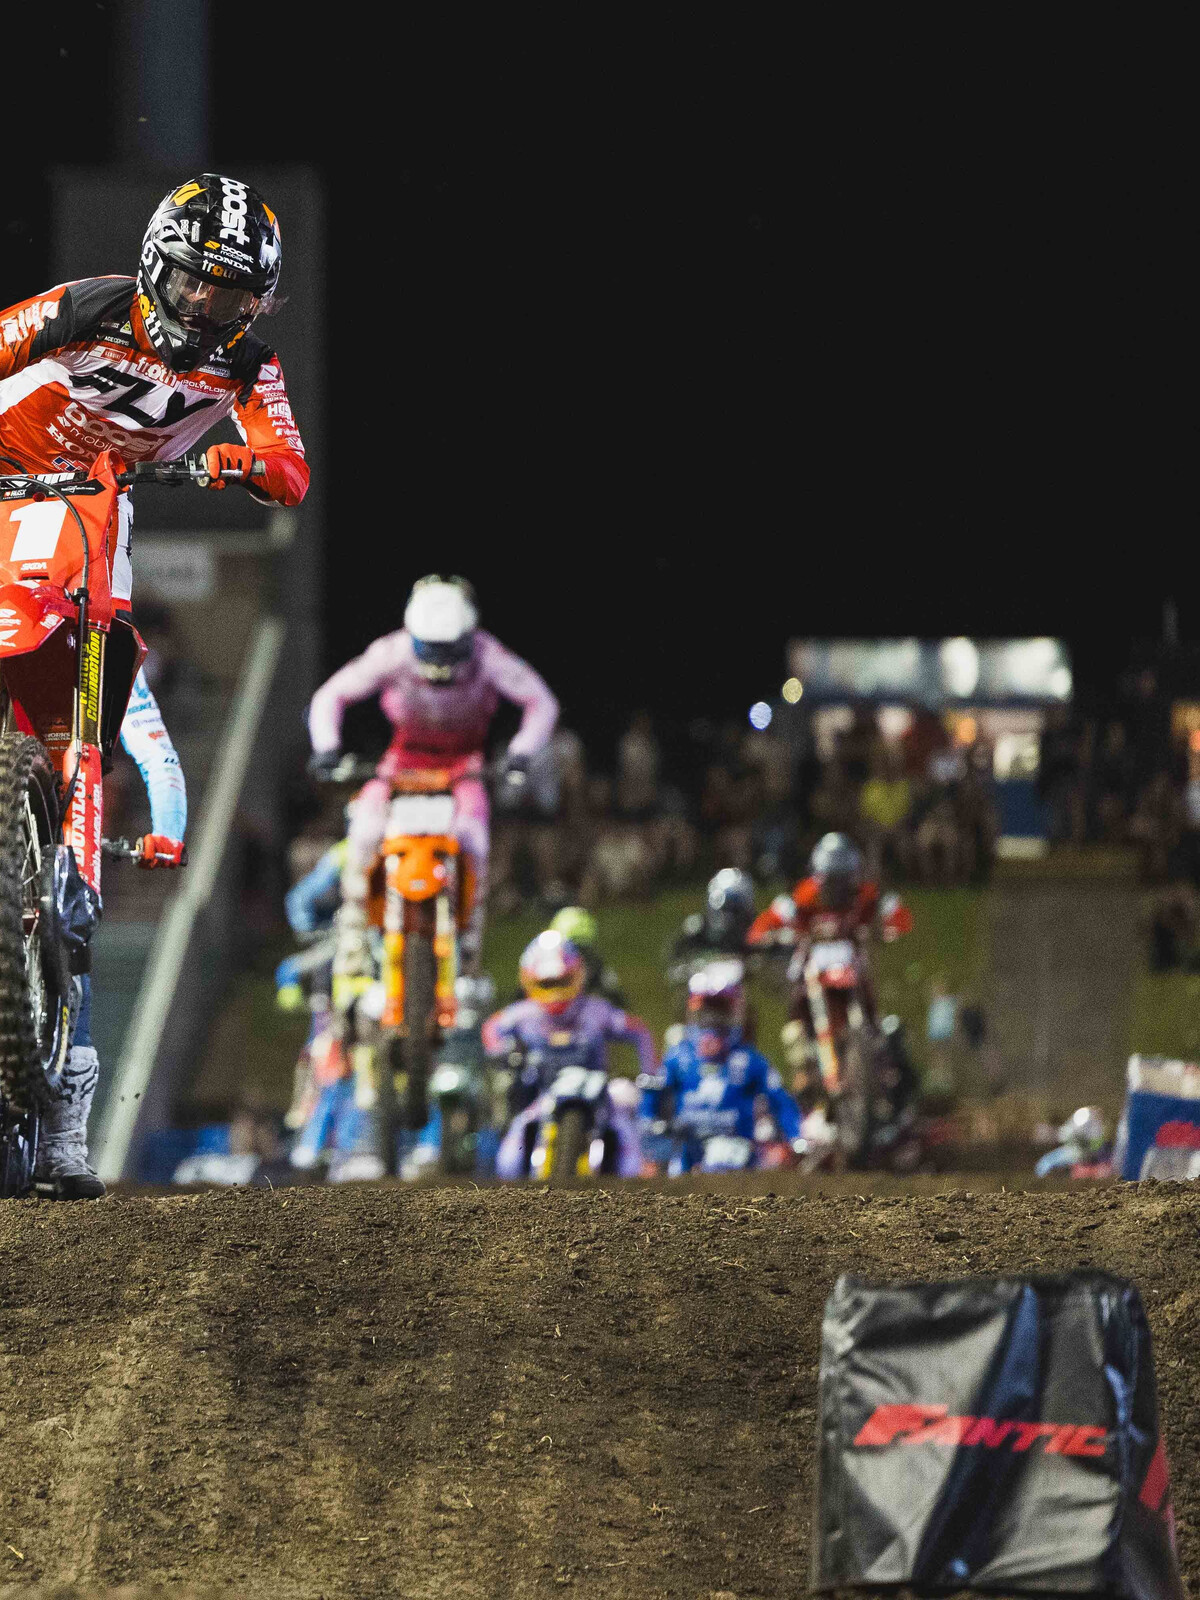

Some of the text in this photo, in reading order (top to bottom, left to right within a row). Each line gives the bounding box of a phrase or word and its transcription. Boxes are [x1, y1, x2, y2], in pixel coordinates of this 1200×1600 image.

[219, 177, 250, 246] boost
[203, 250, 253, 274] HONDA
[221, 243, 254, 264] boost
[181, 379, 227, 395] POLYFLOR
[9, 500, 68, 562] 1
[20, 562, 47, 571] SKDA
[86, 631, 100, 722] Connection
[853, 1403, 1107, 1457] FANTIC
